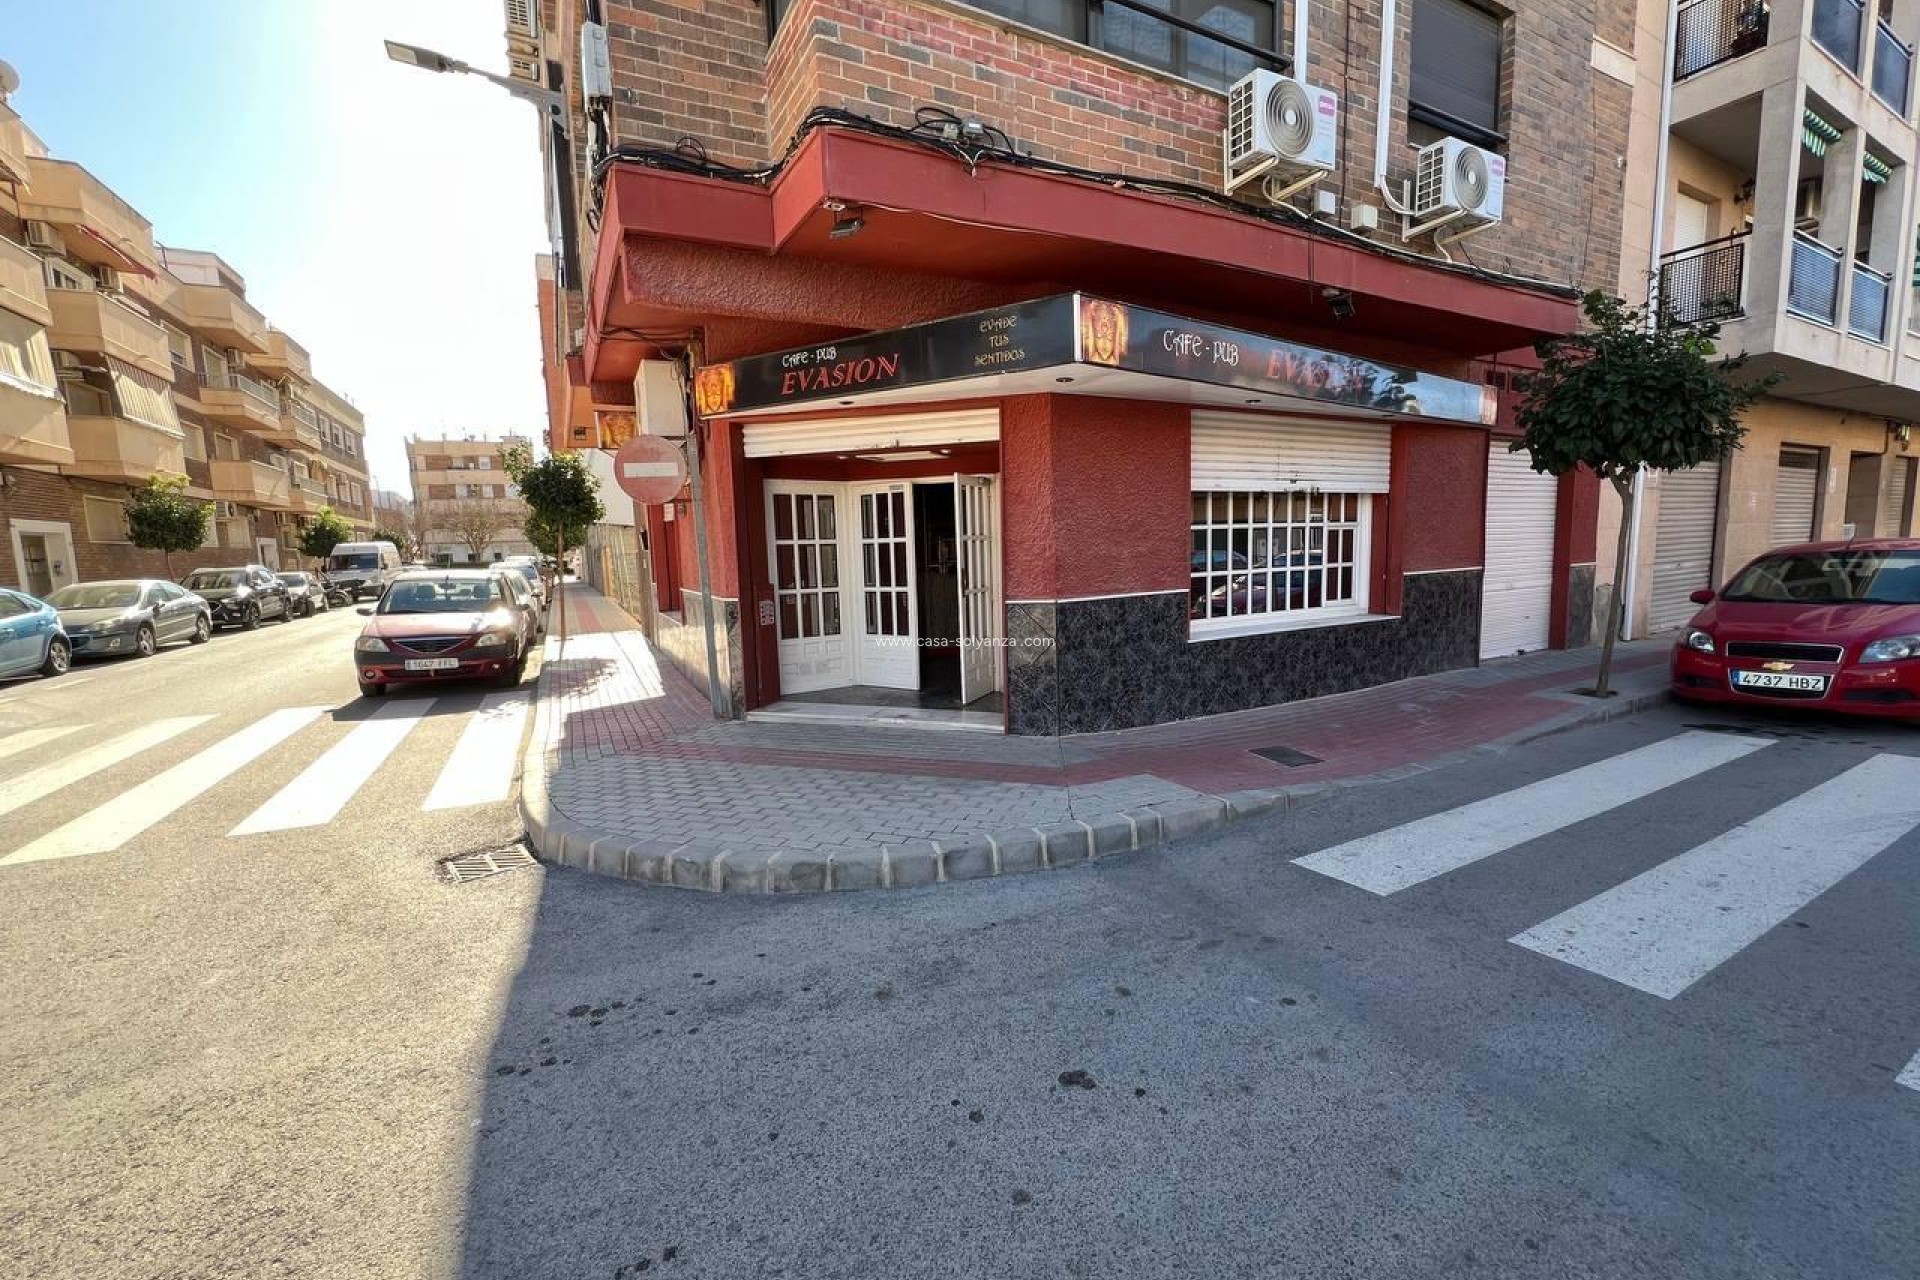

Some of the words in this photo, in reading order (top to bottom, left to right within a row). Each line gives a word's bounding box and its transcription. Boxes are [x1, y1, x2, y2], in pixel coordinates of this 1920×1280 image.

[782, 351, 809, 368] CAFE
[815, 346, 837, 363] PUB
[1163, 330, 1203, 356] CAFE
[1212, 340, 1239, 366] PUB
[781, 352, 900, 395] EVASION
[1742, 674, 1783, 686] 4737
